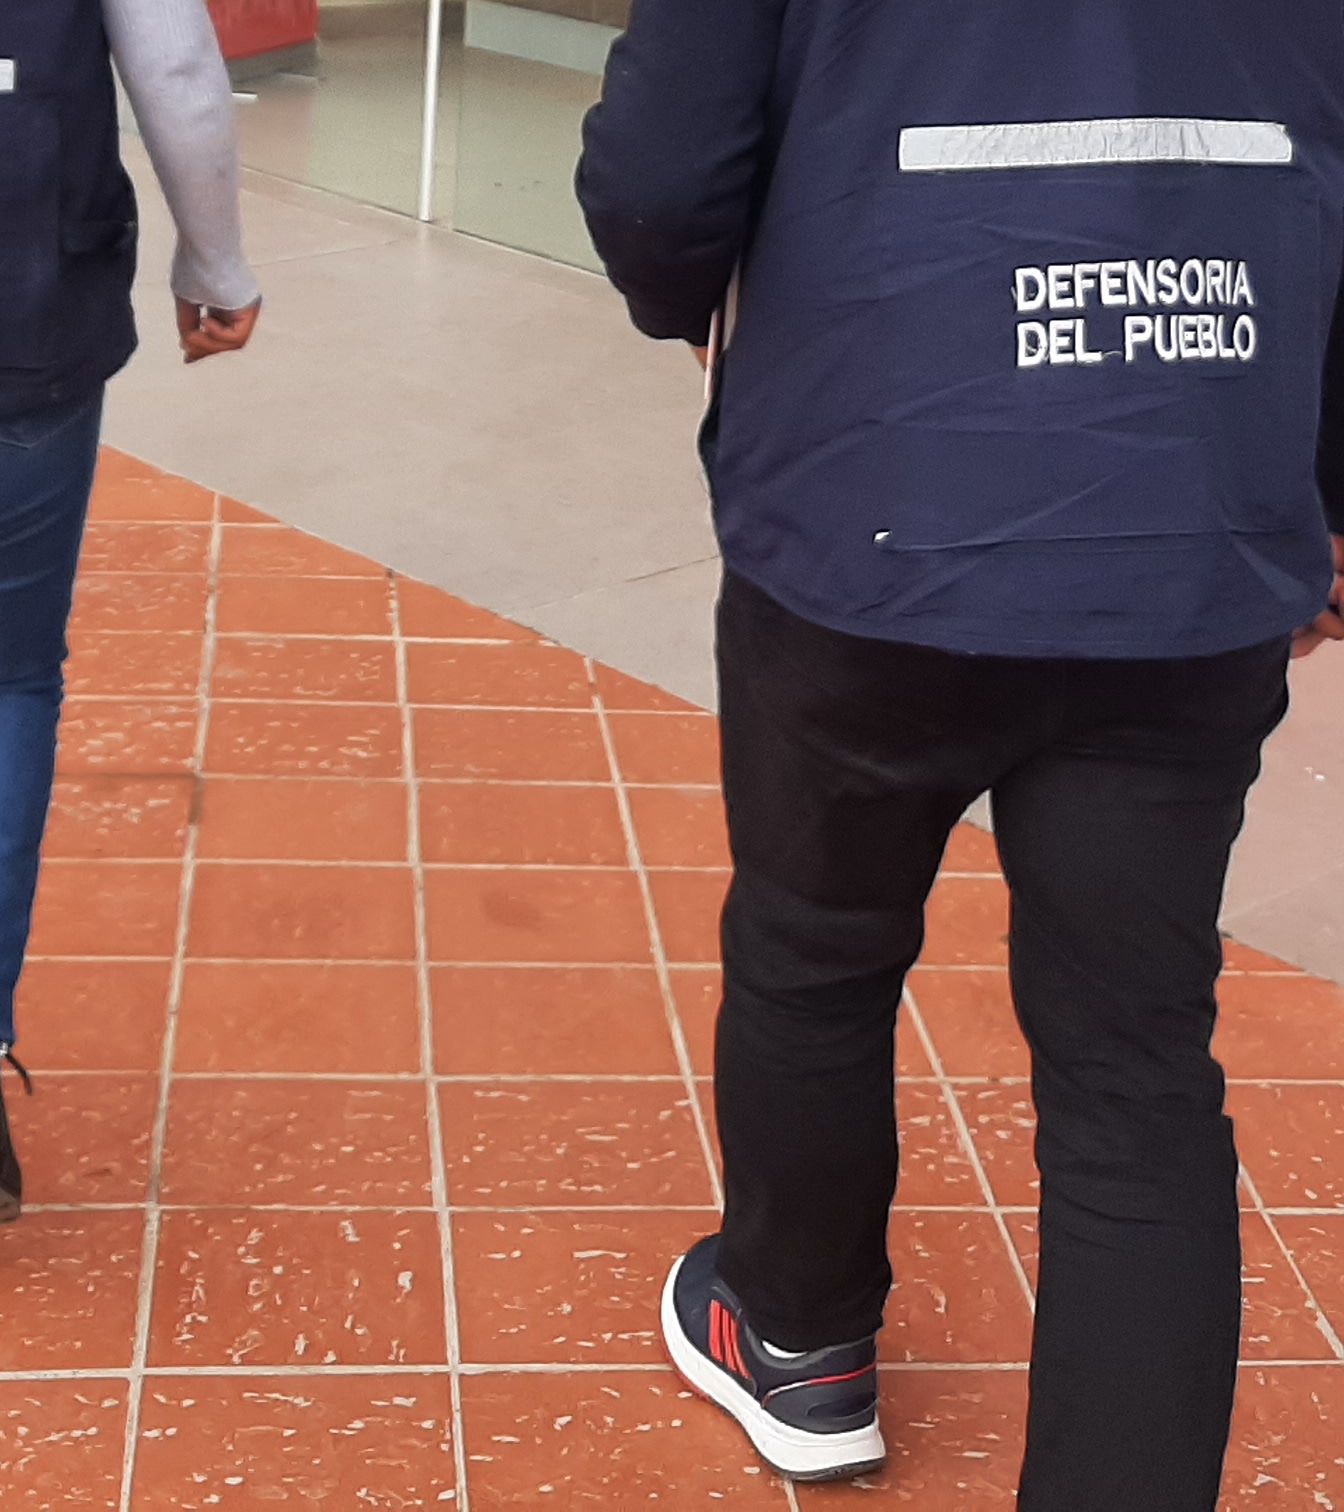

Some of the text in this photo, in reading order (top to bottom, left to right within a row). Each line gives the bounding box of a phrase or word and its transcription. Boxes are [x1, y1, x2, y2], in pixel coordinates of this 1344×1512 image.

[1013, 257, 1256, 312] DEFENSORIA
[1015, 313, 1256, 368] DEL PUEBLO
